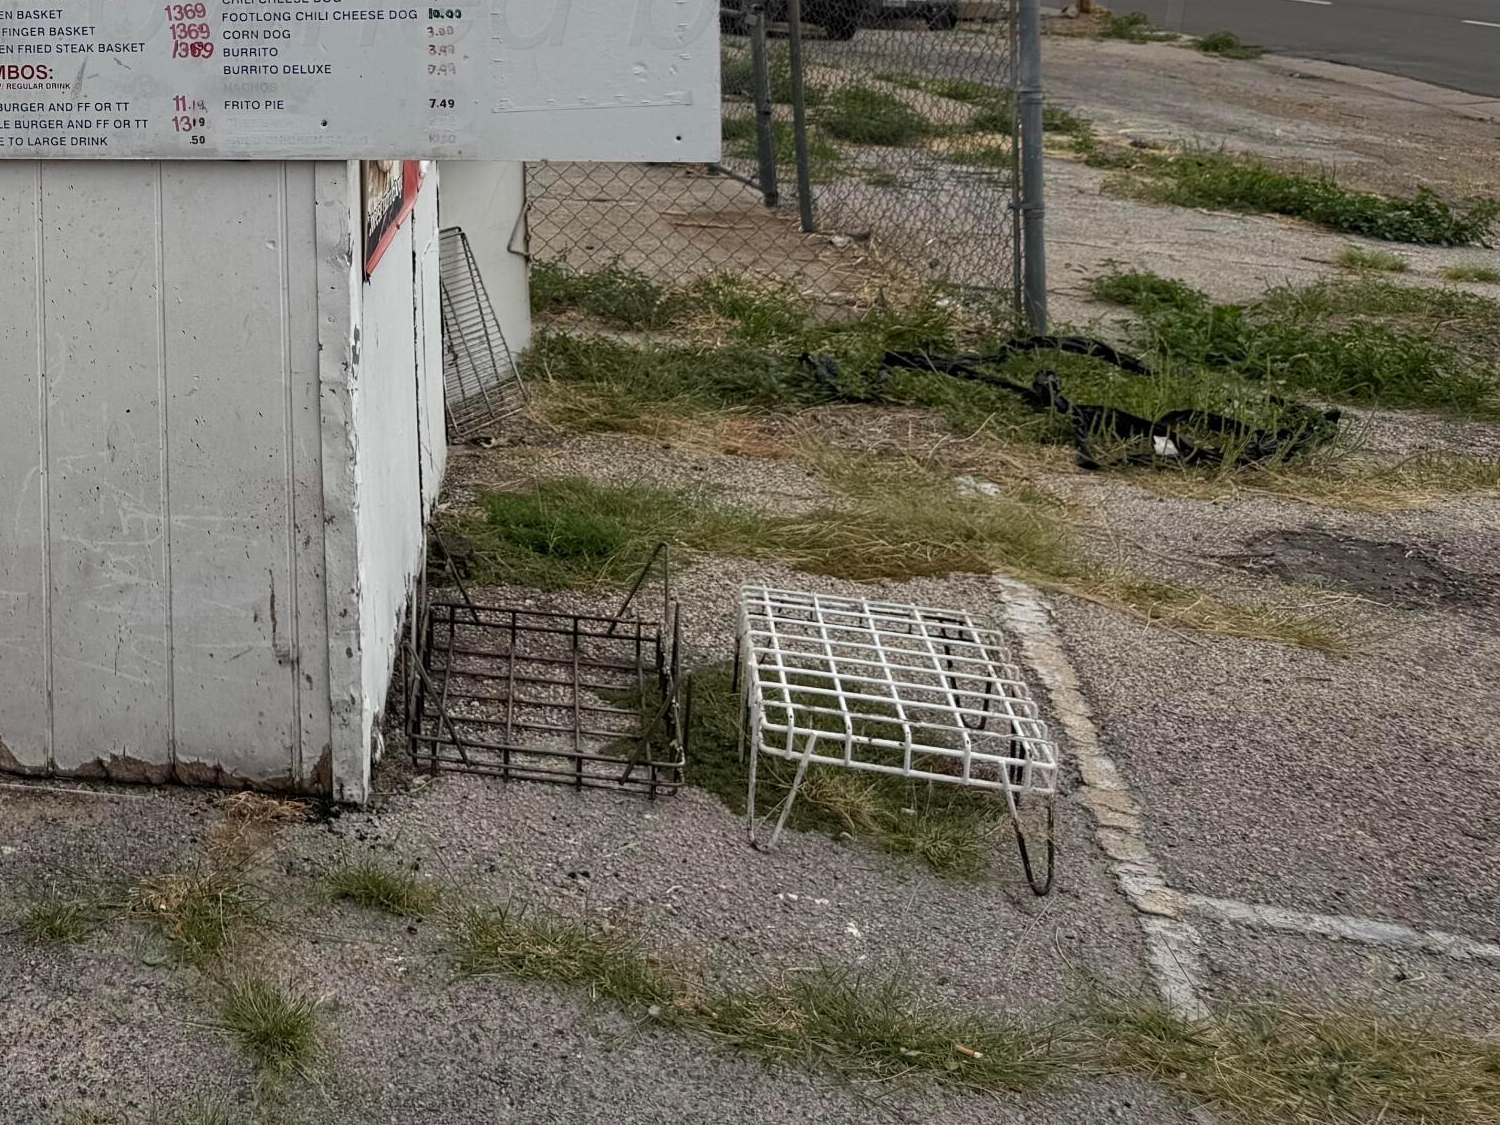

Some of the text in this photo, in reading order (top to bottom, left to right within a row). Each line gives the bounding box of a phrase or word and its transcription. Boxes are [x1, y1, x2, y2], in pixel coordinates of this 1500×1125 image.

[17, 9, 62, 19] BASKET
[222, 9, 417, 22] FOOTLONG CHILI CHEESE DOG
[2, 27, 44, 36] FINGER
[49, 26, 95, 36] BASKET
[222, 29, 290, 39] CORN DOG
[18, 44, 51, 53] FRIED
[56, 43, 94, 53] STEAK
[98, 42, 145, 52] BASKET
[223, 47, 278, 57] BURRITO
[224, 64, 331, 74] BURRITO DELUXE
[48, 102, 72, 111] AND
[77, 102, 90, 112] FF
[94, 102, 111, 111] OR
[115, 102, 129, 111] TT
[224, 100, 284, 109] FRITO PIE
[429, 99, 455, 108] 7.49
[14, 119, 63, 130] BURGER
[8, 137, 23, 146] TO
[28, 136, 66, 146] LARGE
[70, 136, 107, 146] DRINK
